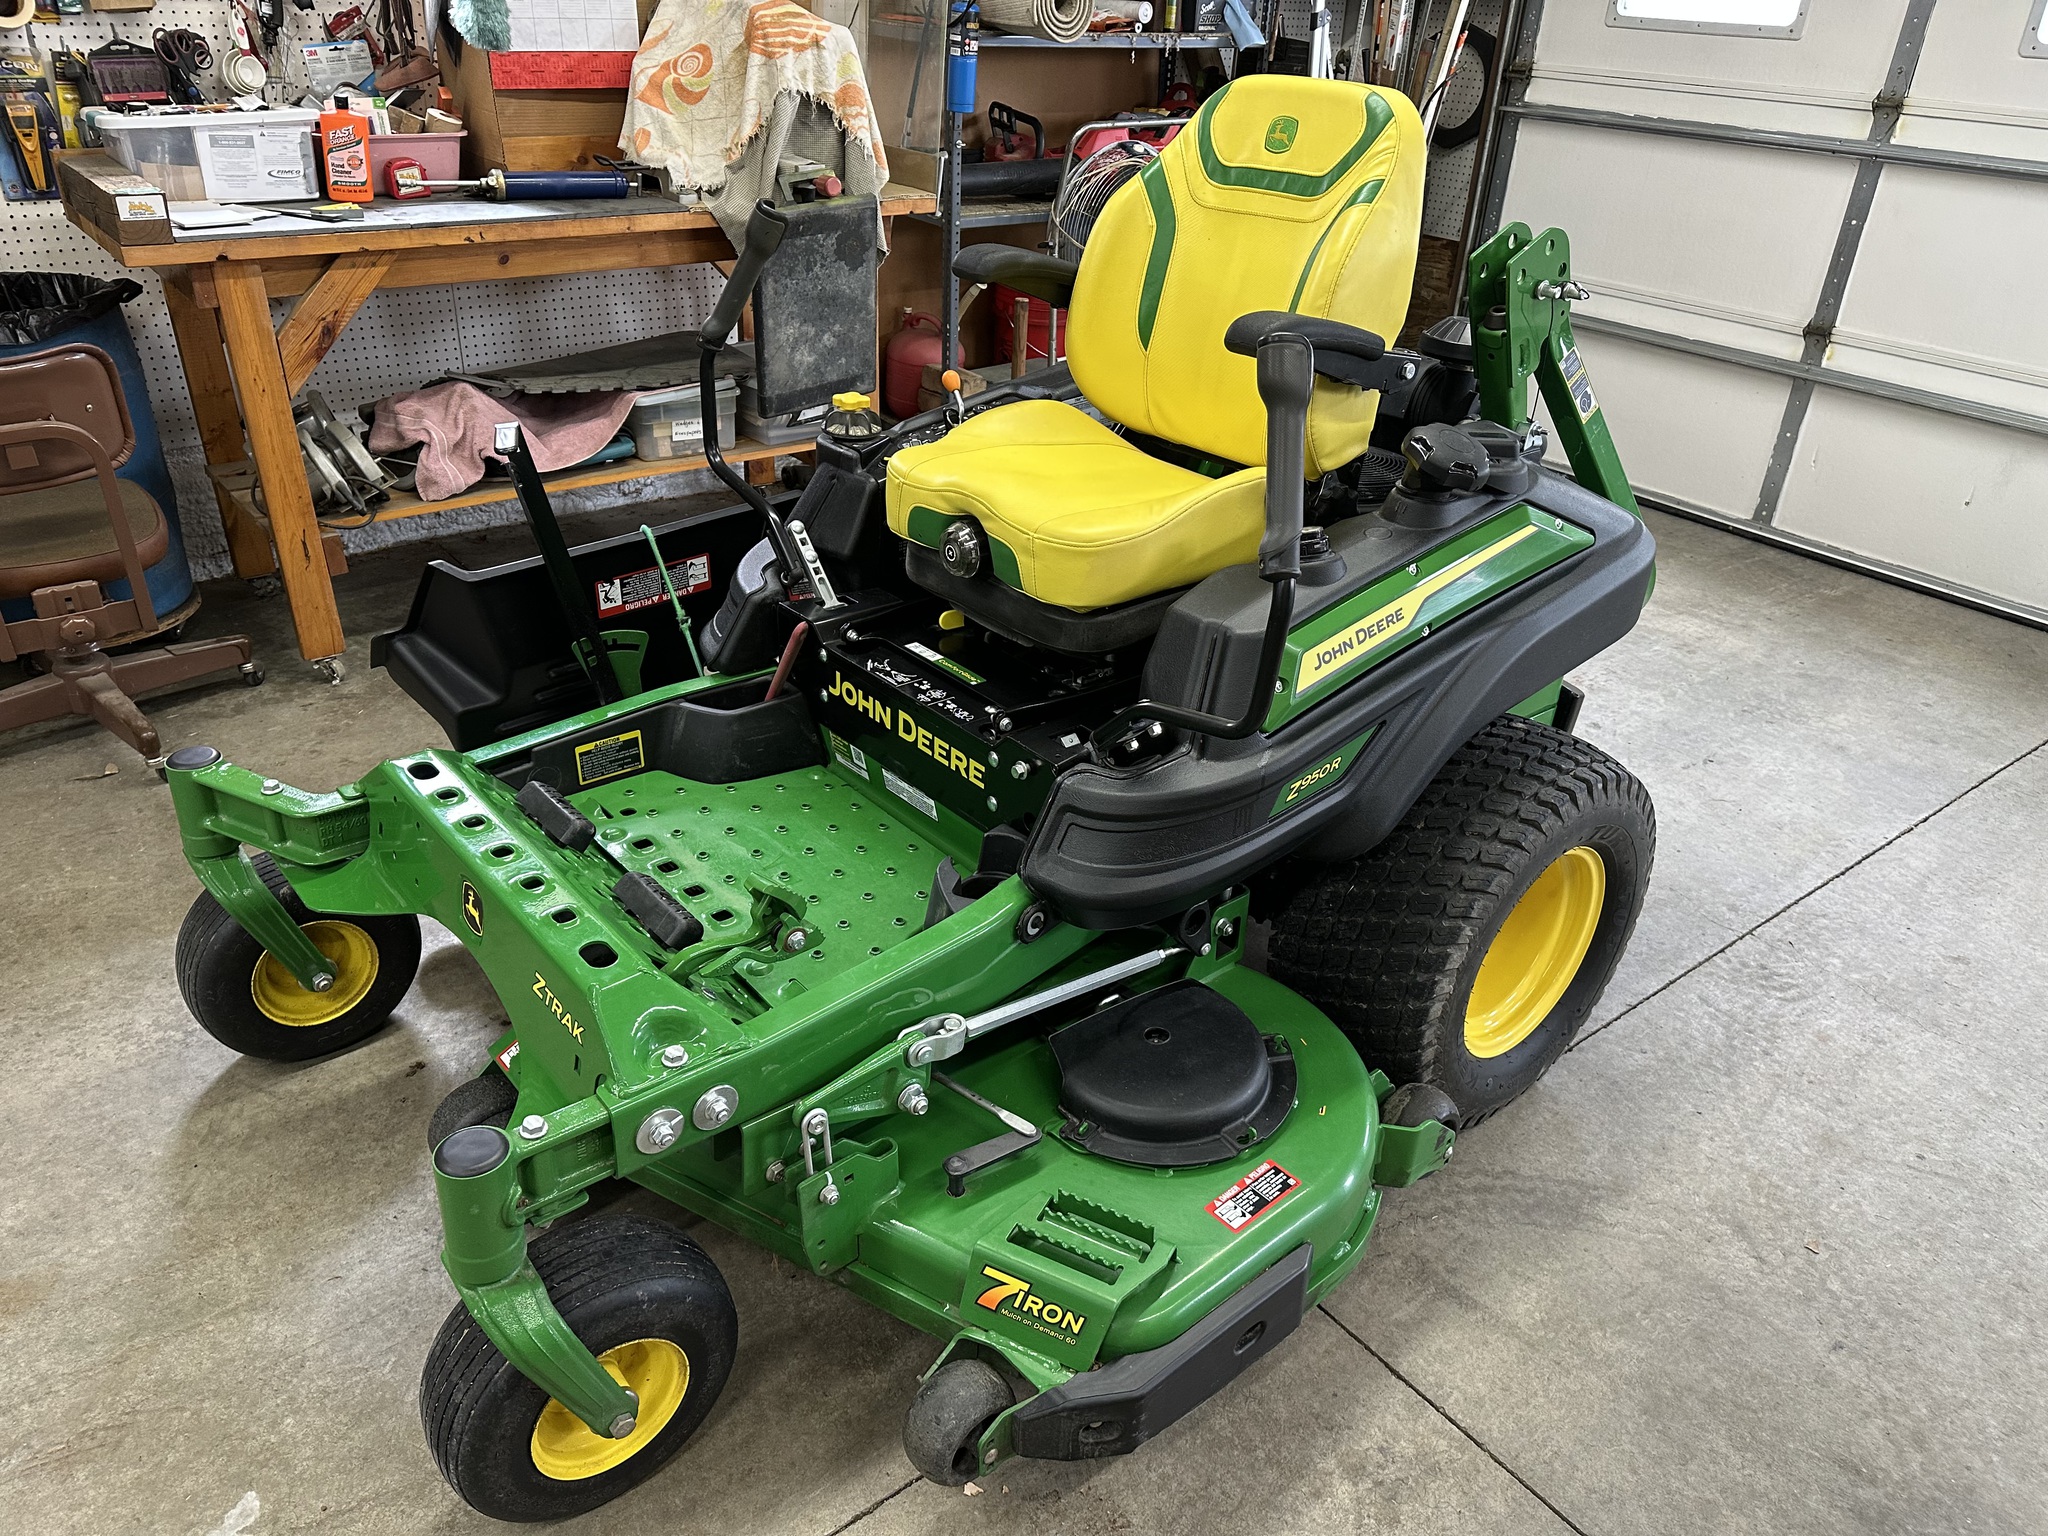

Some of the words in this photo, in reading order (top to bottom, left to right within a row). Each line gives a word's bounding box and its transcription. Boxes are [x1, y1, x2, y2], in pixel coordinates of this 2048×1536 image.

[1199, 13, 1222, 24] SHOP
[305, 49, 318, 57] 3M
[329, 124, 356, 140] FAST
[330, 133, 357, 146] ORANGE
[330, 161, 345, 169] Hand
[331, 167, 353, 175] Cleaner
[662, 588, 687, 601] DANER
[625, 600, 652, 611] PELIGRO
[1314, 637, 1354, 671] JOHN
[1355, 607, 1405, 646] DEERE
[828, 670, 891, 730] JOHN
[898, 709, 986, 790] DEERE
[598, 737, 620, 747] CAUTION
[1285, 756, 1342, 803] Z950R
[532, 970, 586, 1047] ZTRAK
[1218, 1184, 1241, 1201] DANGER
[1248, 1162, 1271, 1180] PELIGRO
[1000, 1308, 1022, 1322] Mulch
[1022, 1319, 1032, 1327] on
[1033, 1322, 1065, 1341] Demand
[1065, 1336, 1077, 1346] 60
